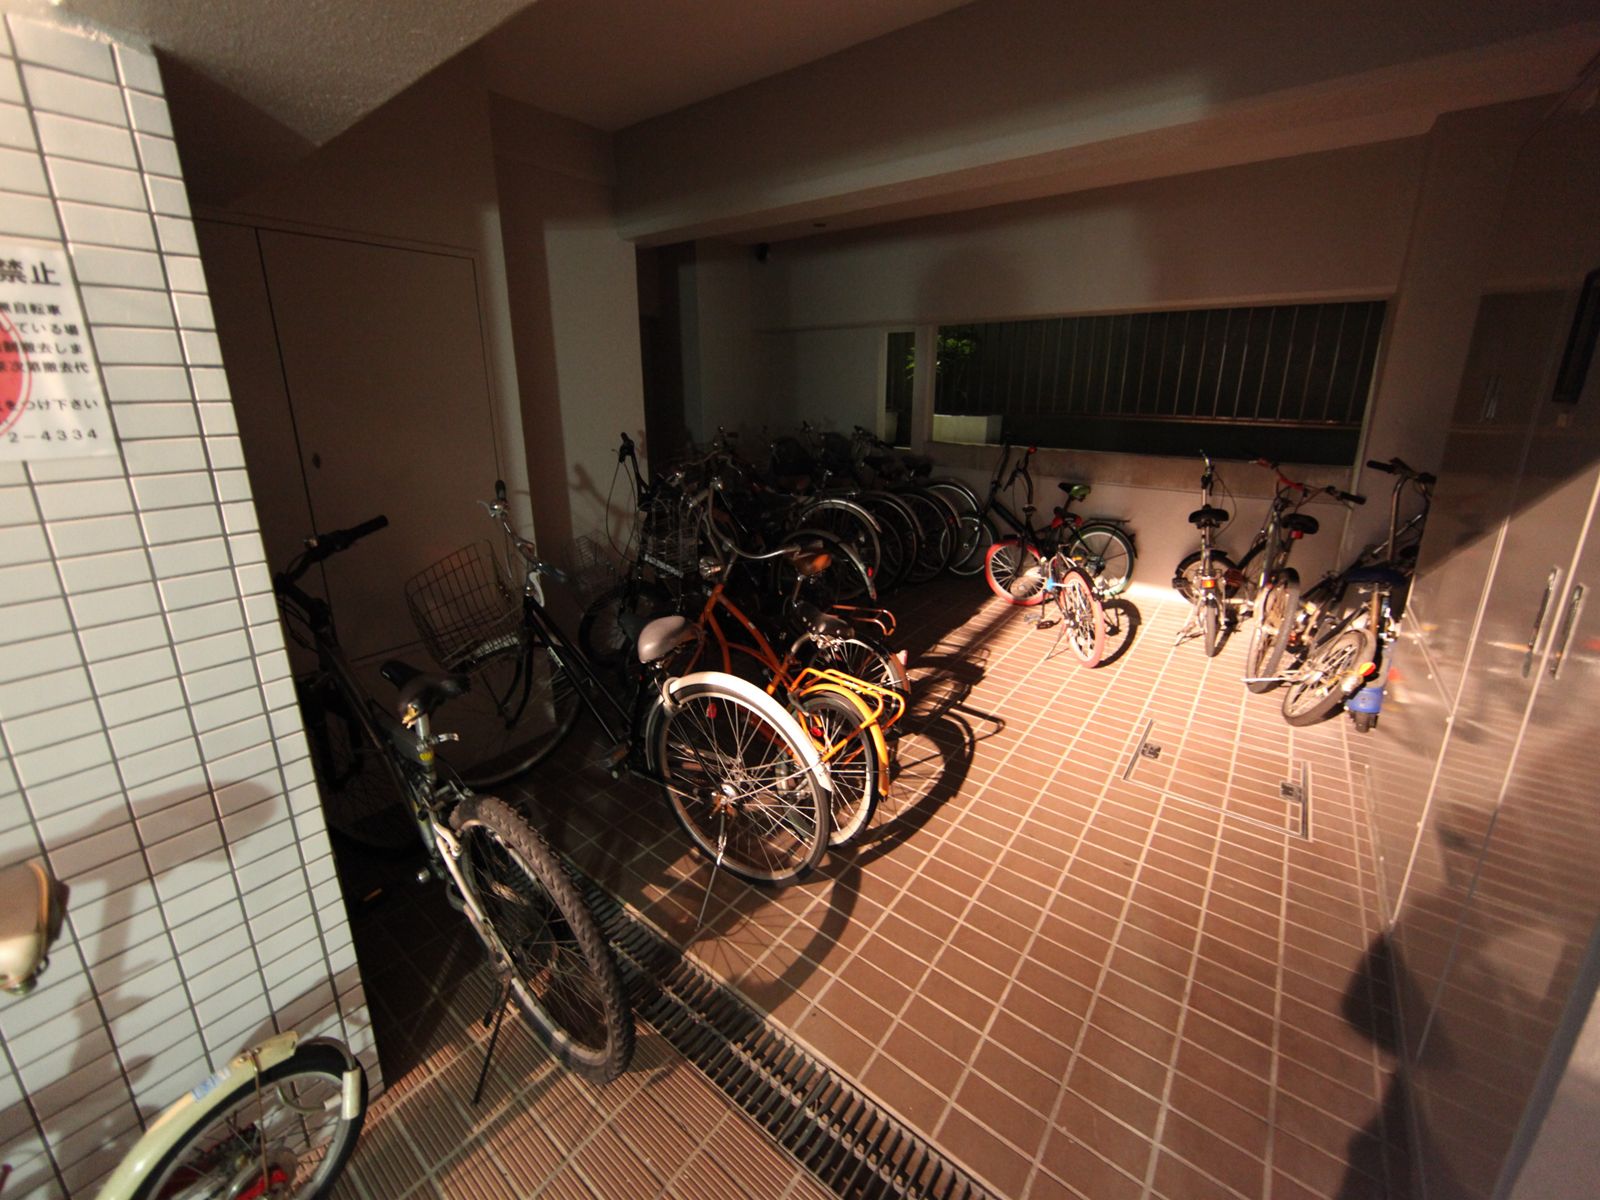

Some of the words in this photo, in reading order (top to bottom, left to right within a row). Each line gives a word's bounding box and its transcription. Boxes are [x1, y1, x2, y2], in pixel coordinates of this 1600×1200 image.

[0, 258, 61, 286] 禁止
[0, 399, 98, 411] をつけ下さい
